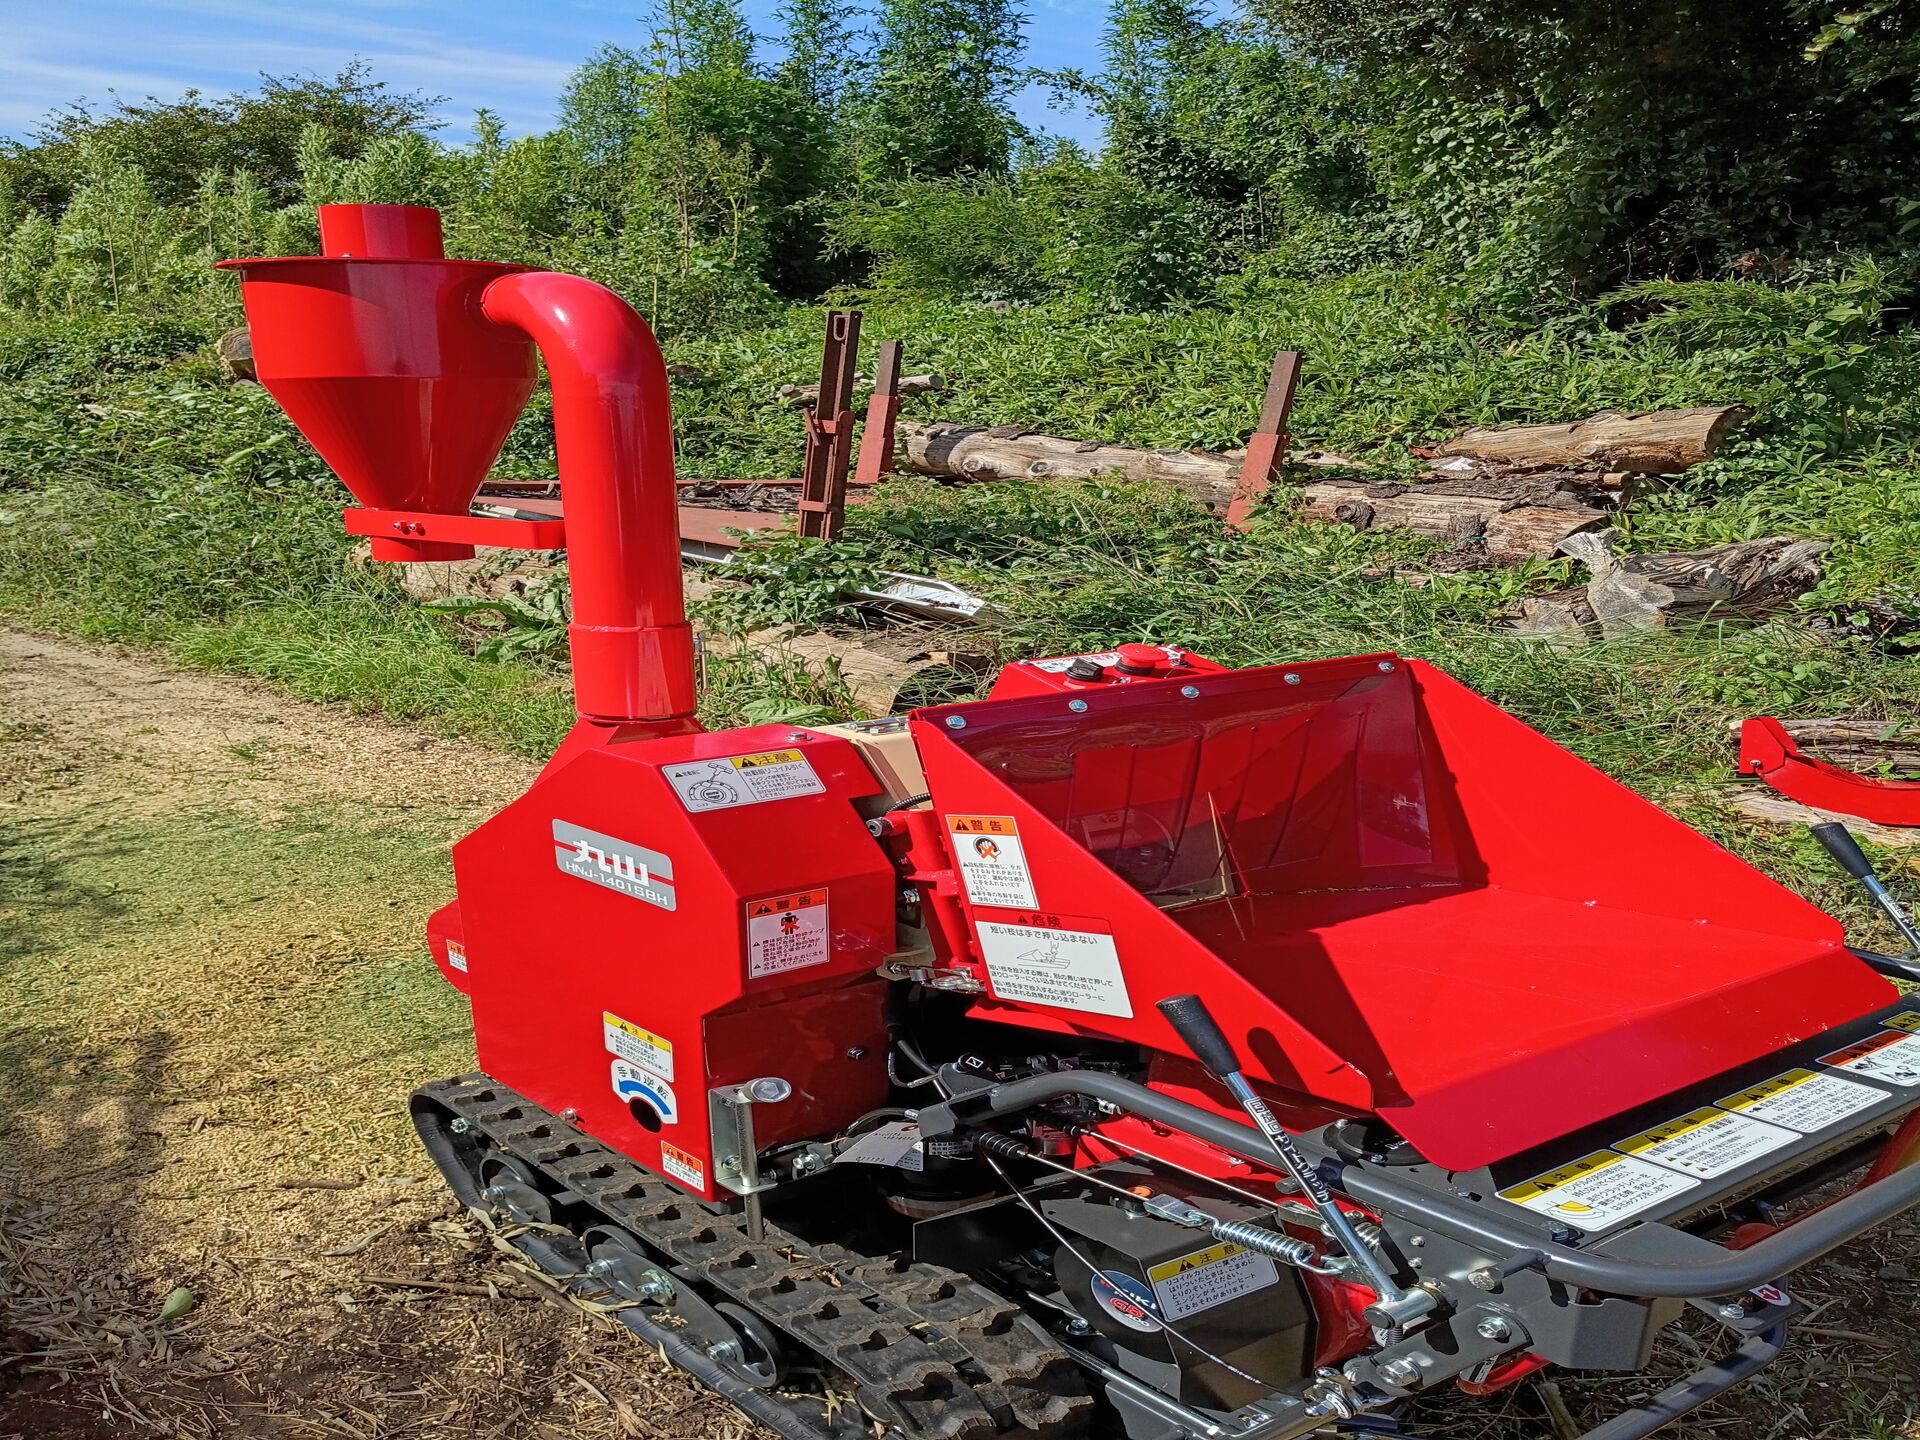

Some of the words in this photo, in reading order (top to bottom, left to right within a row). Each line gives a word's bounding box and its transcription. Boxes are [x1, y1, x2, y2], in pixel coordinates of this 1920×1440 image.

[753, 751, 792, 764] 注意
[969, 819, 1002, 831] 警告
[573, 840, 650, 887] 丸山
[565, 860, 668, 905] HNJ-1401SBH
[1030, 914, 1062, 928] 危険
[989, 925, 1097, 945] 短い枝は手で押し込まない
[1198, 1242, 1236, 1264] 注意
[1170, 1268, 1243, 1300] とりのぞいてください。
[1173, 1271, 1256, 1307] エンジンがオーバーヒート
[1176, 1281, 1249, 1313] するおそれがあります。
